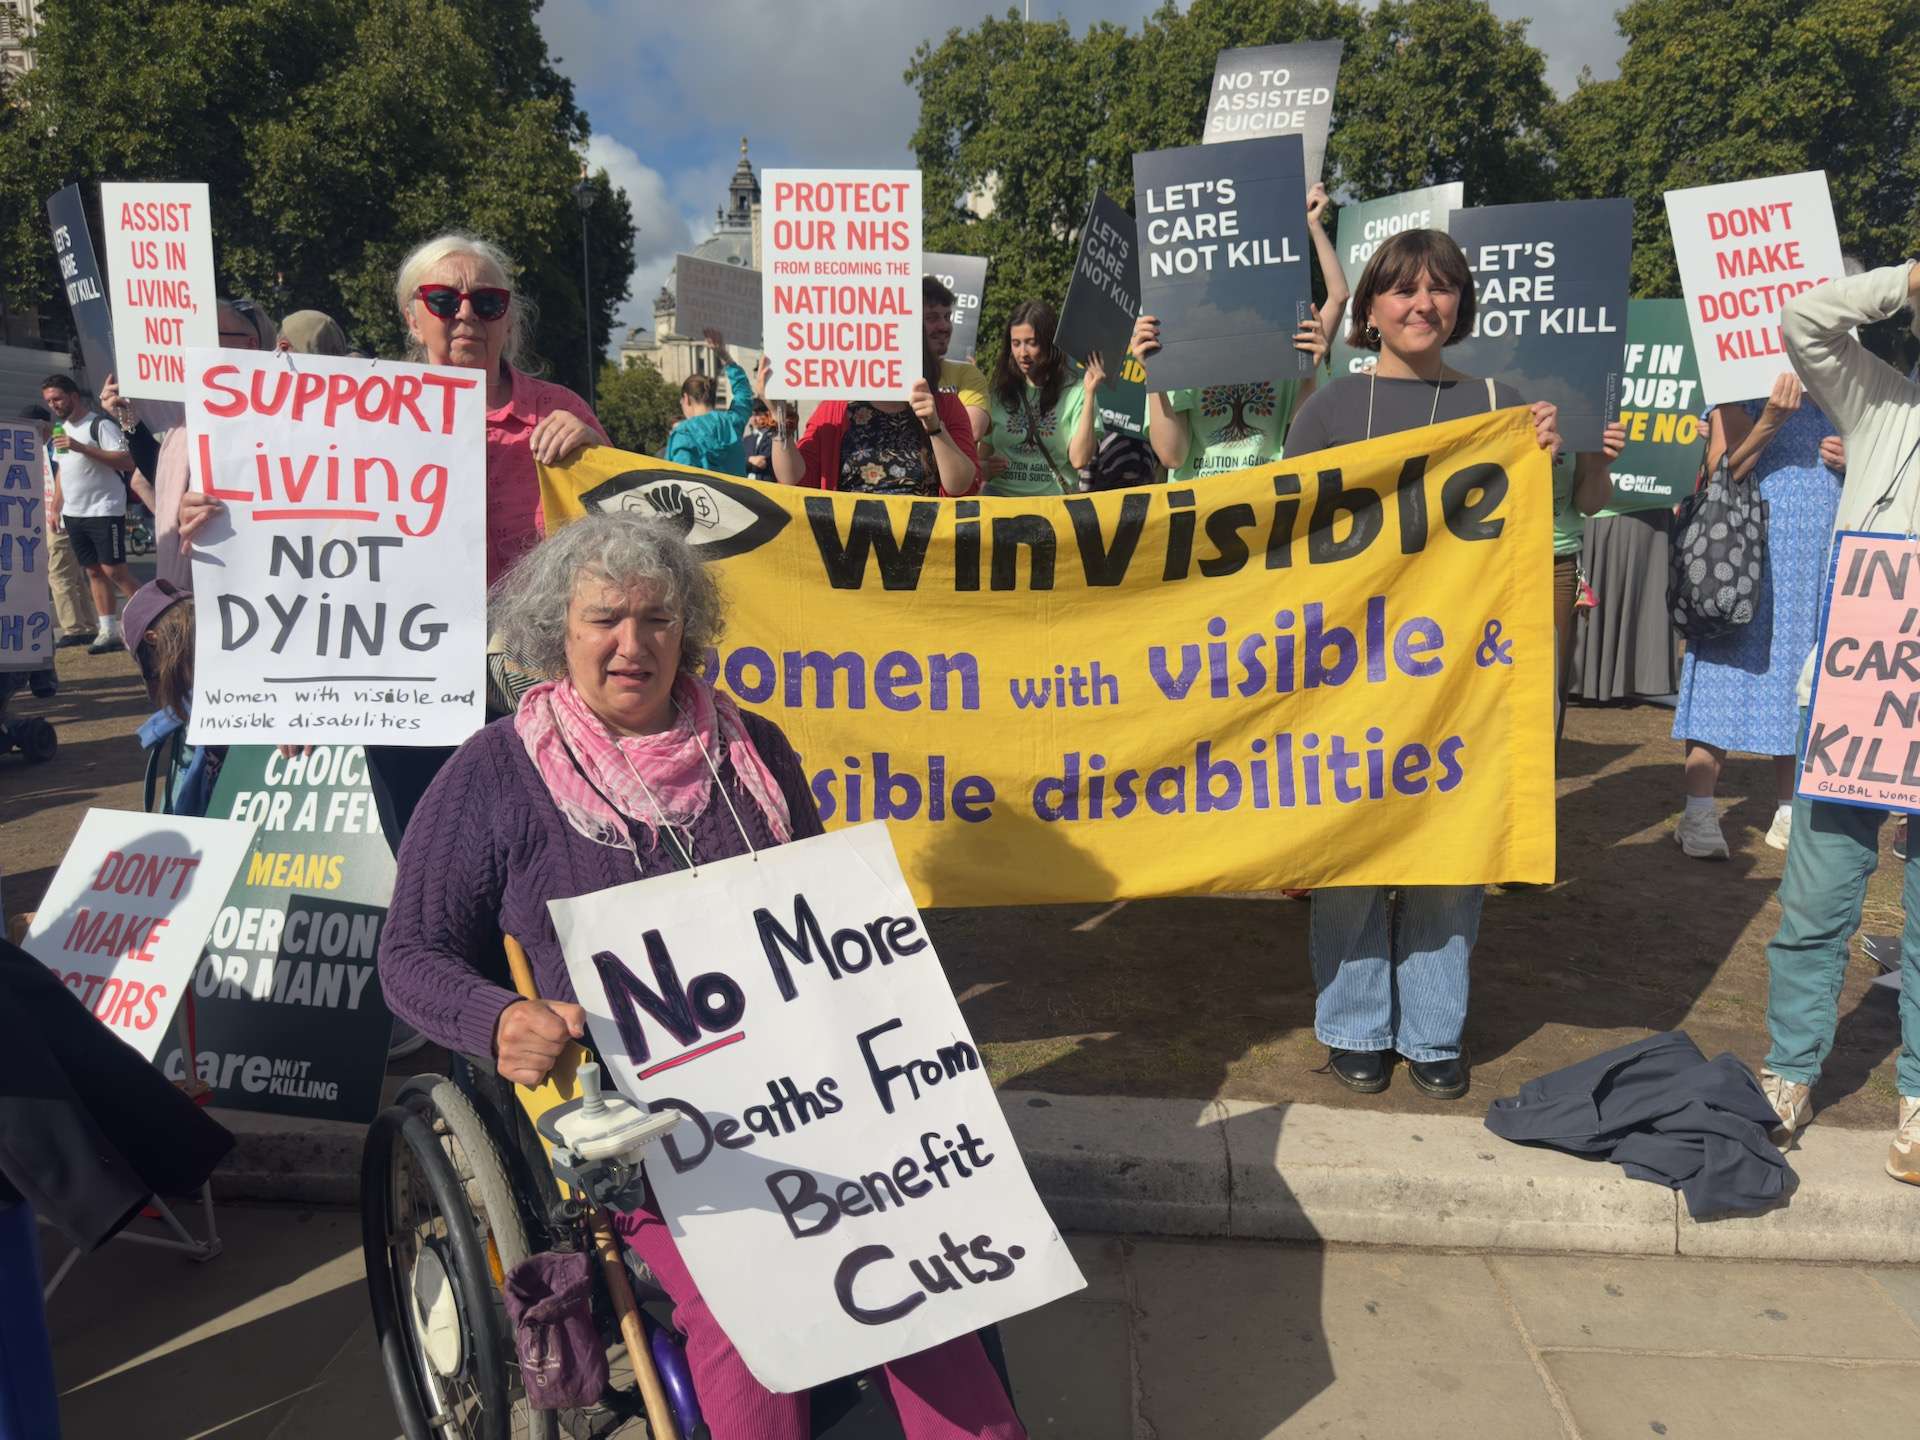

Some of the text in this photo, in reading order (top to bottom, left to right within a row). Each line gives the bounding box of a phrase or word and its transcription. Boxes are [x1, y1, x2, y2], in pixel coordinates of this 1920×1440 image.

[1219, 69, 1290, 90] NO TO
[1214, 88, 1330, 112] ASSISTED
[1210, 110, 1306, 132] SUICIDE
[774, 182, 910, 213] PROTECT
[1146, 178, 1236, 213] LET'S
[121, 203, 191, 232] ASSIST
[1147, 210, 1239, 245] CARE
[1707, 202, 1793, 240] DON'T
[773, 220, 910, 251] OUR NHS
[1092, 215, 1129, 259] LET'S
[131, 242, 186, 270] US IN
[774, 261, 910, 276] FROM BECOMING THE
[1087, 237, 1124, 280] CARE
[1150, 237, 1300, 277] NOT KILL
[1716, 241, 1804, 279] MAKE
[77, 277, 100, 302] KILL
[127, 280, 198, 314] LIVING,
[774, 285, 912, 315] NATIONAL
[1081, 256, 1136, 319] NOT KILL
[1474, 275, 1555, 304] ARE
[145, 319, 184, 346] NOT
[787, 322, 899, 352] SUICIDE
[1540, 306, 1617, 335] KILL
[138, 353, 184, 383] DYIN
[784, 358, 902, 389] SERVICE
[1648, 344, 1683, 375] IN
[202, 364, 477, 435] SUPPORT
[1652, 413, 1698, 445] NO
[4, 464, 31, 490] A
[198, 434, 448, 537] Living
[1634, 485, 1672, 495] KILLING
[804, 455, 1508, 591] WinVisible
[269, 535, 403, 582] NOT
[1841, 548, 1920, 600] IN
[1010, 662, 1119, 709] with
[1149, 596, 1444, 700] visible
[1475, 619, 1513, 668] &
[205, 689, 277, 705] Women
[295, 686, 339, 702] with
[441, 689, 475, 706] and
[288, 711, 421, 729] disabilities
[1032, 727, 1465, 822] disabilities
[1818, 781, 1920, 803] GLOBAL WOME
[229, 791, 293, 832] FOR
[293, 792, 318, 832] A
[92, 850, 200, 900] DON'T
[246, 852, 345, 890] MEANS
[64, 909, 170, 961] MAKE
[207, 905, 379, 960] OERCION
[193, 954, 375, 1010] OR MANY
[592, 893, 928, 1066] No More
[164, 1047, 311, 1094] care NOT
[269, 1077, 338, 1101] KILLING
[646, 1018, 979, 1175] Deaths From
[765, 1123, 994, 1239] Benefit
[834, 1232, 1026, 1326] Cuts.
